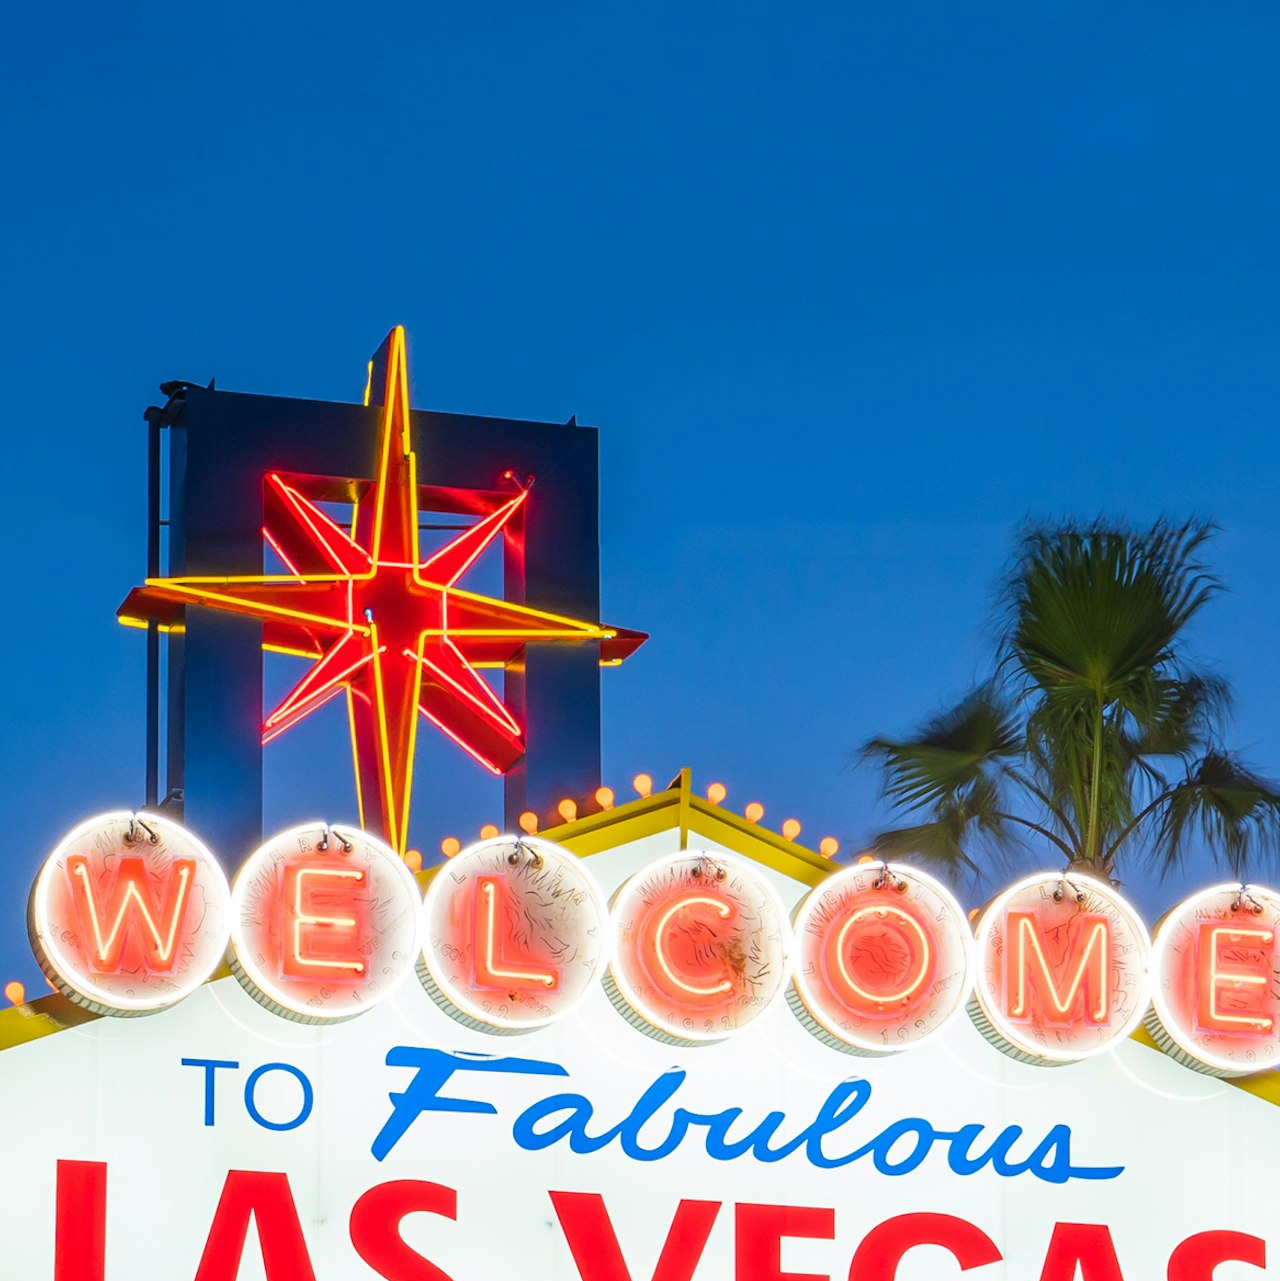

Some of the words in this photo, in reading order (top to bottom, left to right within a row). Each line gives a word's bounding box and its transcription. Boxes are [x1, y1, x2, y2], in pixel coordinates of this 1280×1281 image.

[66, 855, 1275, 1036] WELCOME
[181, 1058, 314, 1132] TO
[371, 1046, 1125, 1185] Fabulous
